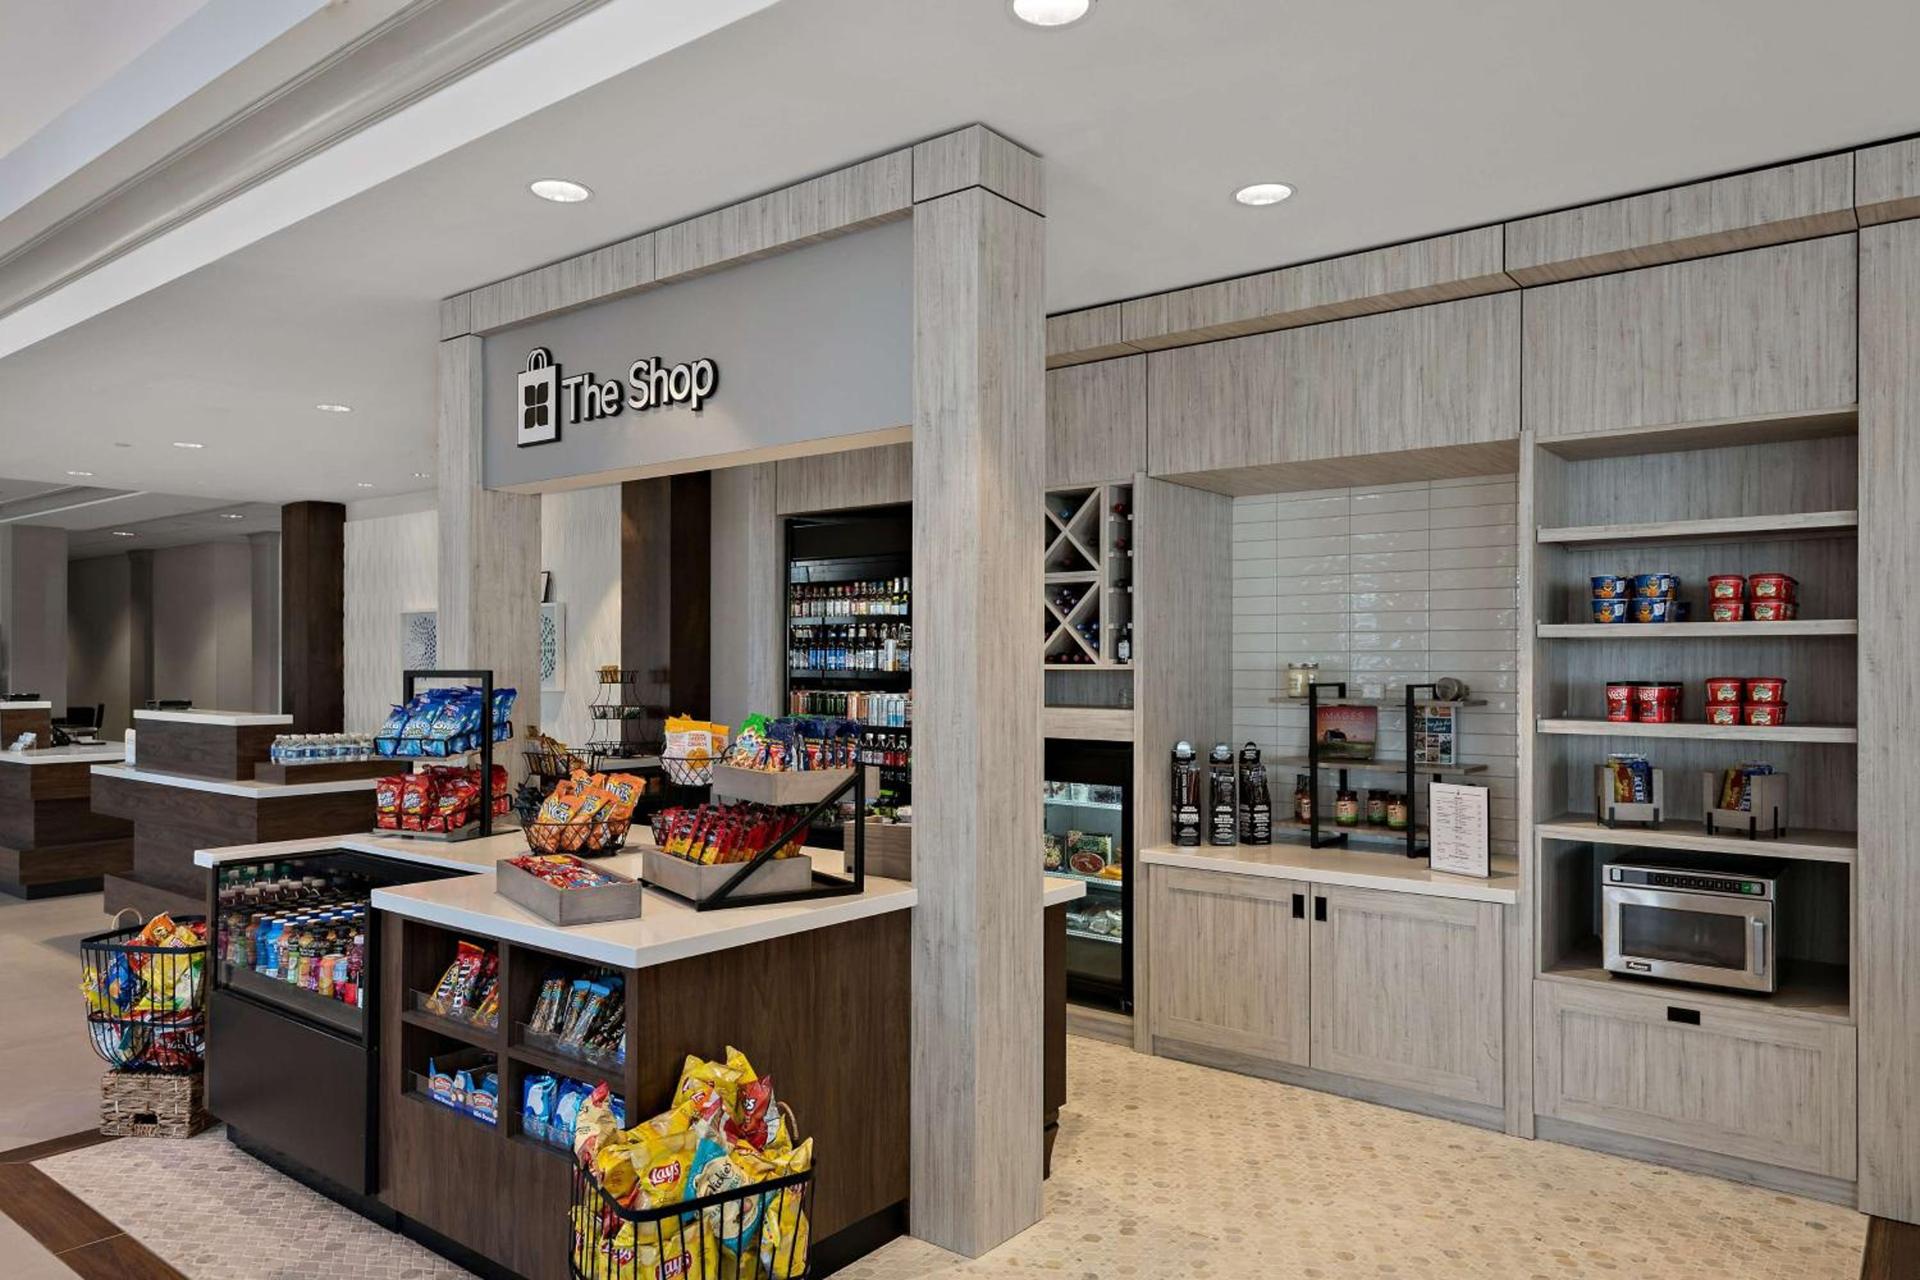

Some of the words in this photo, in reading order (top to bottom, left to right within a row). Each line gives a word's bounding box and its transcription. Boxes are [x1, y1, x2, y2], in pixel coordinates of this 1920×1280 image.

[562, 373, 622, 423] The
[627, 357, 718, 410] Shop
[1321, 711, 1365, 719] IMAGES
